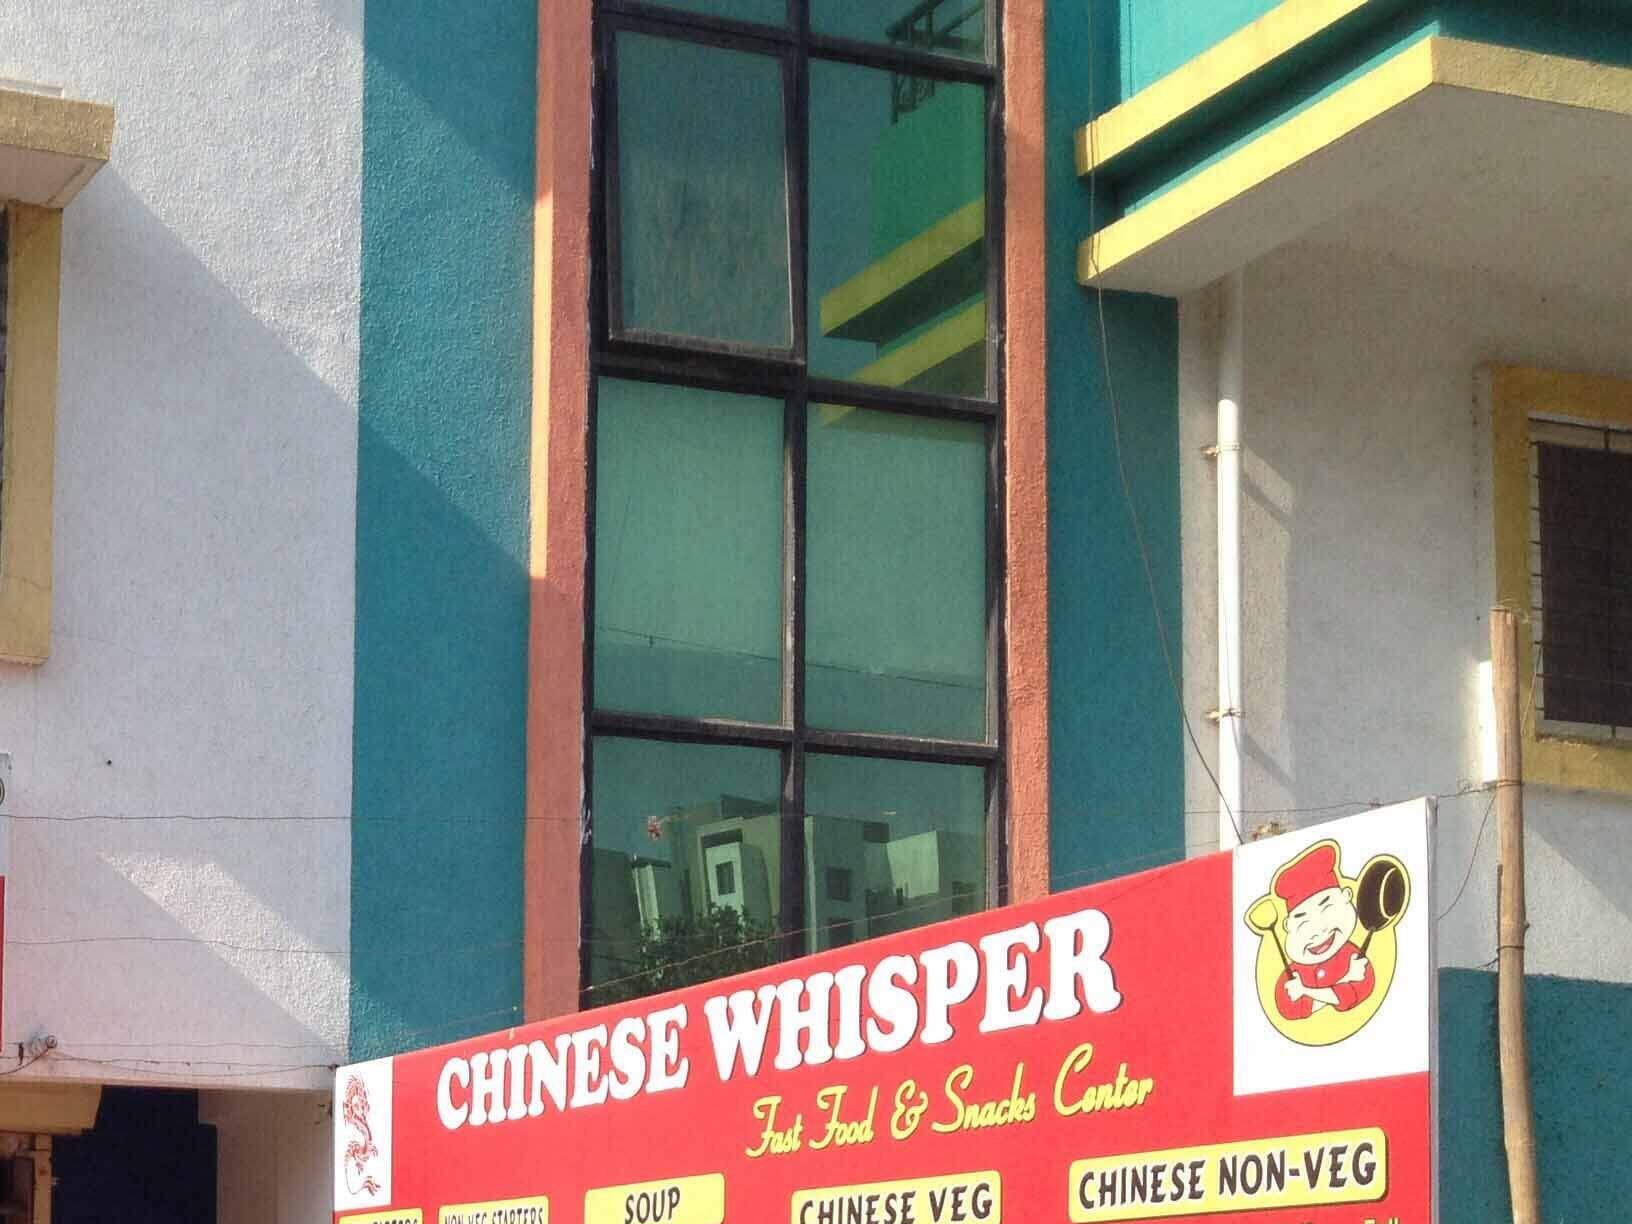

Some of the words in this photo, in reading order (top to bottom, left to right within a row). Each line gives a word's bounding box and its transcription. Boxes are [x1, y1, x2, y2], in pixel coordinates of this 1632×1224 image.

[437, 1004, 688, 1130] CHINESE
[704, 909, 1122, 1081] WHISPER
[745, 1095, 803, 1157] Fast
[809, 1085, 878, 1149] Food
[890, 1080, 928, 1140] &
[932, 1062, 1036, 1132] Snacks
[1054, 1043, 1153, 1116] Center
[929, 1183, 992, 1223] VEG
[1079, 1159, 1206, 1210] CHINESE
[1218, 1143, 1377, 1198] NON-VEG
